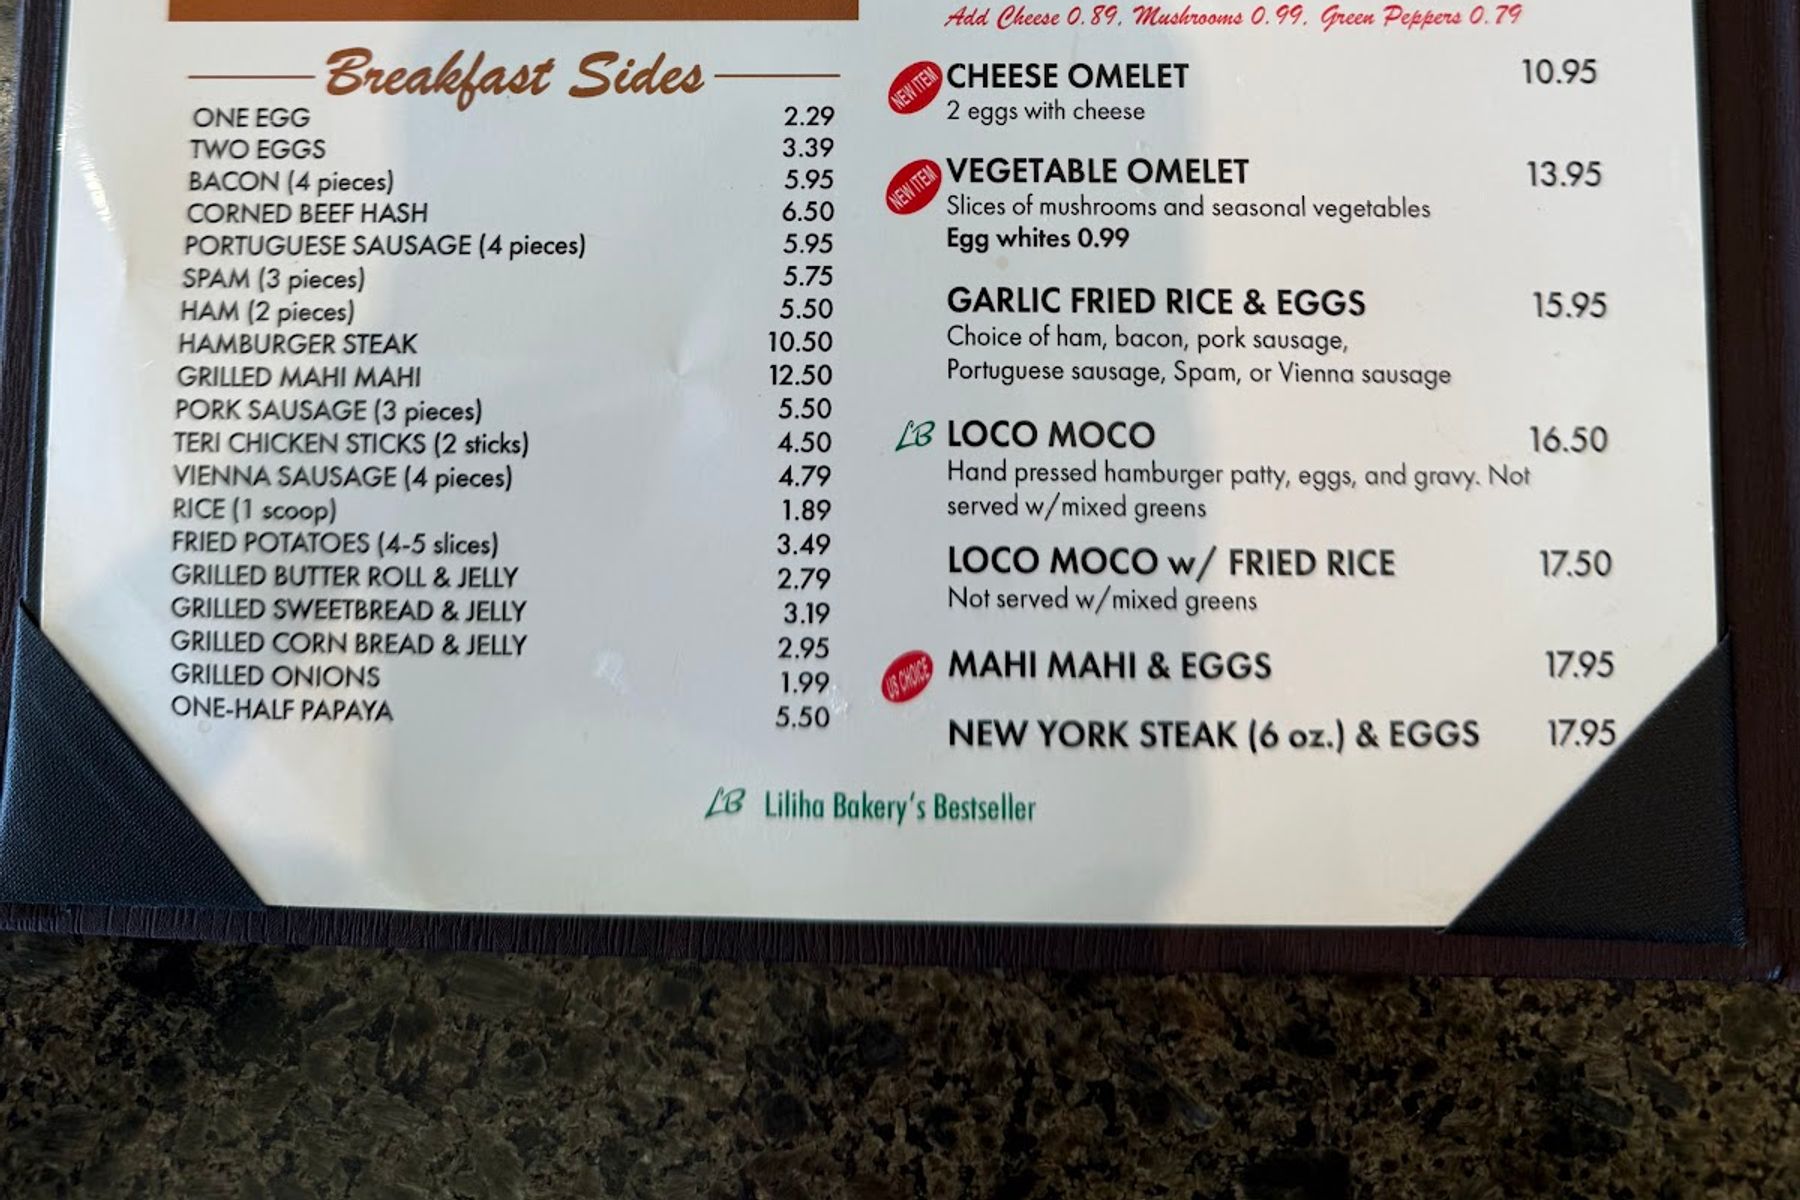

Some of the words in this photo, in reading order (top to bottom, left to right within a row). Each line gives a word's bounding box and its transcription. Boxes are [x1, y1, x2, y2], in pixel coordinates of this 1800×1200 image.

[326, 47, 555, 112] Breakfast
[568, 51, 704, 98] Sides
[947, 63, 1058, 88] CHEESE
[1068, 63, 1189, 88] OMELET
[1523, 59, 1596, 84] 10.95
[890, 83, 917, 110] NEW
[911, 66, 939, 93] ITEM
[193, 108, 249, 127] ONE
[256, 108, 310, 127] EGG
[785, 106, 835, 126] 2.29
[947, 100, 959, 119] 2
[968, 107, 1018, 125] eggs
[1024, 99, 1065, 119] with
[1073, 99, 1145, 120] cheese
[190, 139, 249, 159] TWO
[257, 139, 325, 159] EGGS
[783, 137, 833, 157] 3.39
[189, 171, 279, 191] BACON
[288, 170, 310, 195] (4
[318, 170, 393, 197] pieces)
[785, 169, 833, 189] 5.95
[188, 203, 292, 223] CORNED
[300, 203, 354, 223] BEEF
[361, 203, 427, 223] HASH
[783, 201, 834, 221] 6.50
[186, 236, 346, 256] PORTUGUESE
[353, 235, 471, 256] SAUSAGE
[480, 233, 502, 259] (4
[510, 233, 585, 261] pieces)
[784, 233, 832, 253] 5.95
[948, 227, 988, 253] Egg
[996, 226, 1070, 247] whites
[1078, 228, 1129, 248] 0.99
[948, 287, 1060, 313] GARLIC
[1072, 288, 1155, 313] FRIED
[1167, 288, 1232, 314] RICE
[1244, 289, 1266, 315] &
[1278, 290, 1365, 316] EGGS
[1534, 292, 1606, 318] 15.95
[949, 420, 1037, 447] LOCO
[1049, 421, 1155, 448] MOCO
[1530, 426, 1608, 453] 16.50
[172, 564, 266, 586] GRILLED
[275, 566, 360, 586] BUTTER
[369, 566, 426, 587] ROLL
[433, 567, 450, 588] &
[457, 567, 518, 588] JELLY
[778, 568, 830, 589] 2.79
[171, 663, 264, 686] GRILLED
[272, 666, 380, 688] ONIONS
[949, 650, 1036, 678] MAHI
[1048, 651, 1135, 679] MAHI
[1148, 652, 1170, 679] &
[1182, 652, 1271, 680] EGGS
[1546, 651, 1614, 678] 17.95
[782, 672, 829, 693] 1.99
[171, 695, 294, 720] ONE-HALF
[302, 700, 393, 721] PAPAYA
[776, 706, 830, 728] 5.50
[950, 719, 1028, 747] NEW
[1038, 720, 1128, 748] YORK
[1141, 721, 1237, 748] STEAK
[1249, 719, 1279, 754] (6
[1289, 719, 1344, 754] oz.)
[1356, 720, 1379, 748] &
[1390, 720, 1479, 747] EGGS
[1549, 719, 1615, 746] 17.95
[766, 790, 824, 818] Liliha
[834, 791, 925, 825] Bakery's
[934, 792, 1035, 821] Bestseller
